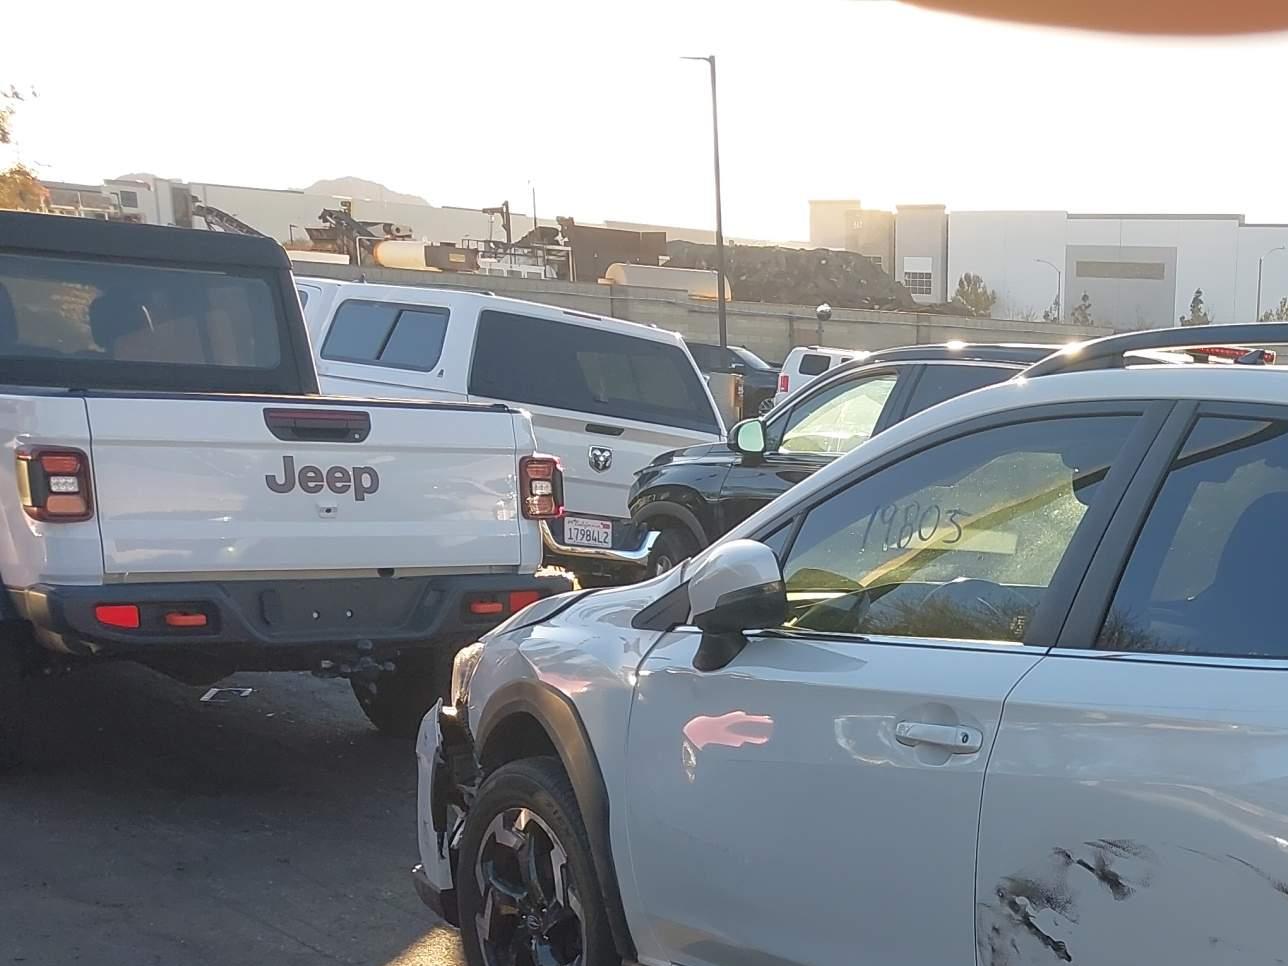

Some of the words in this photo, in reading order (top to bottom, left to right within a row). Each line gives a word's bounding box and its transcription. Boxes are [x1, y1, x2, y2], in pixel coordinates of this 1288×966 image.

[265, 455, 380, 501] Jeep
[567, 527, 610, 544] 17984L2
[862, 501, 972, 550] 19805
